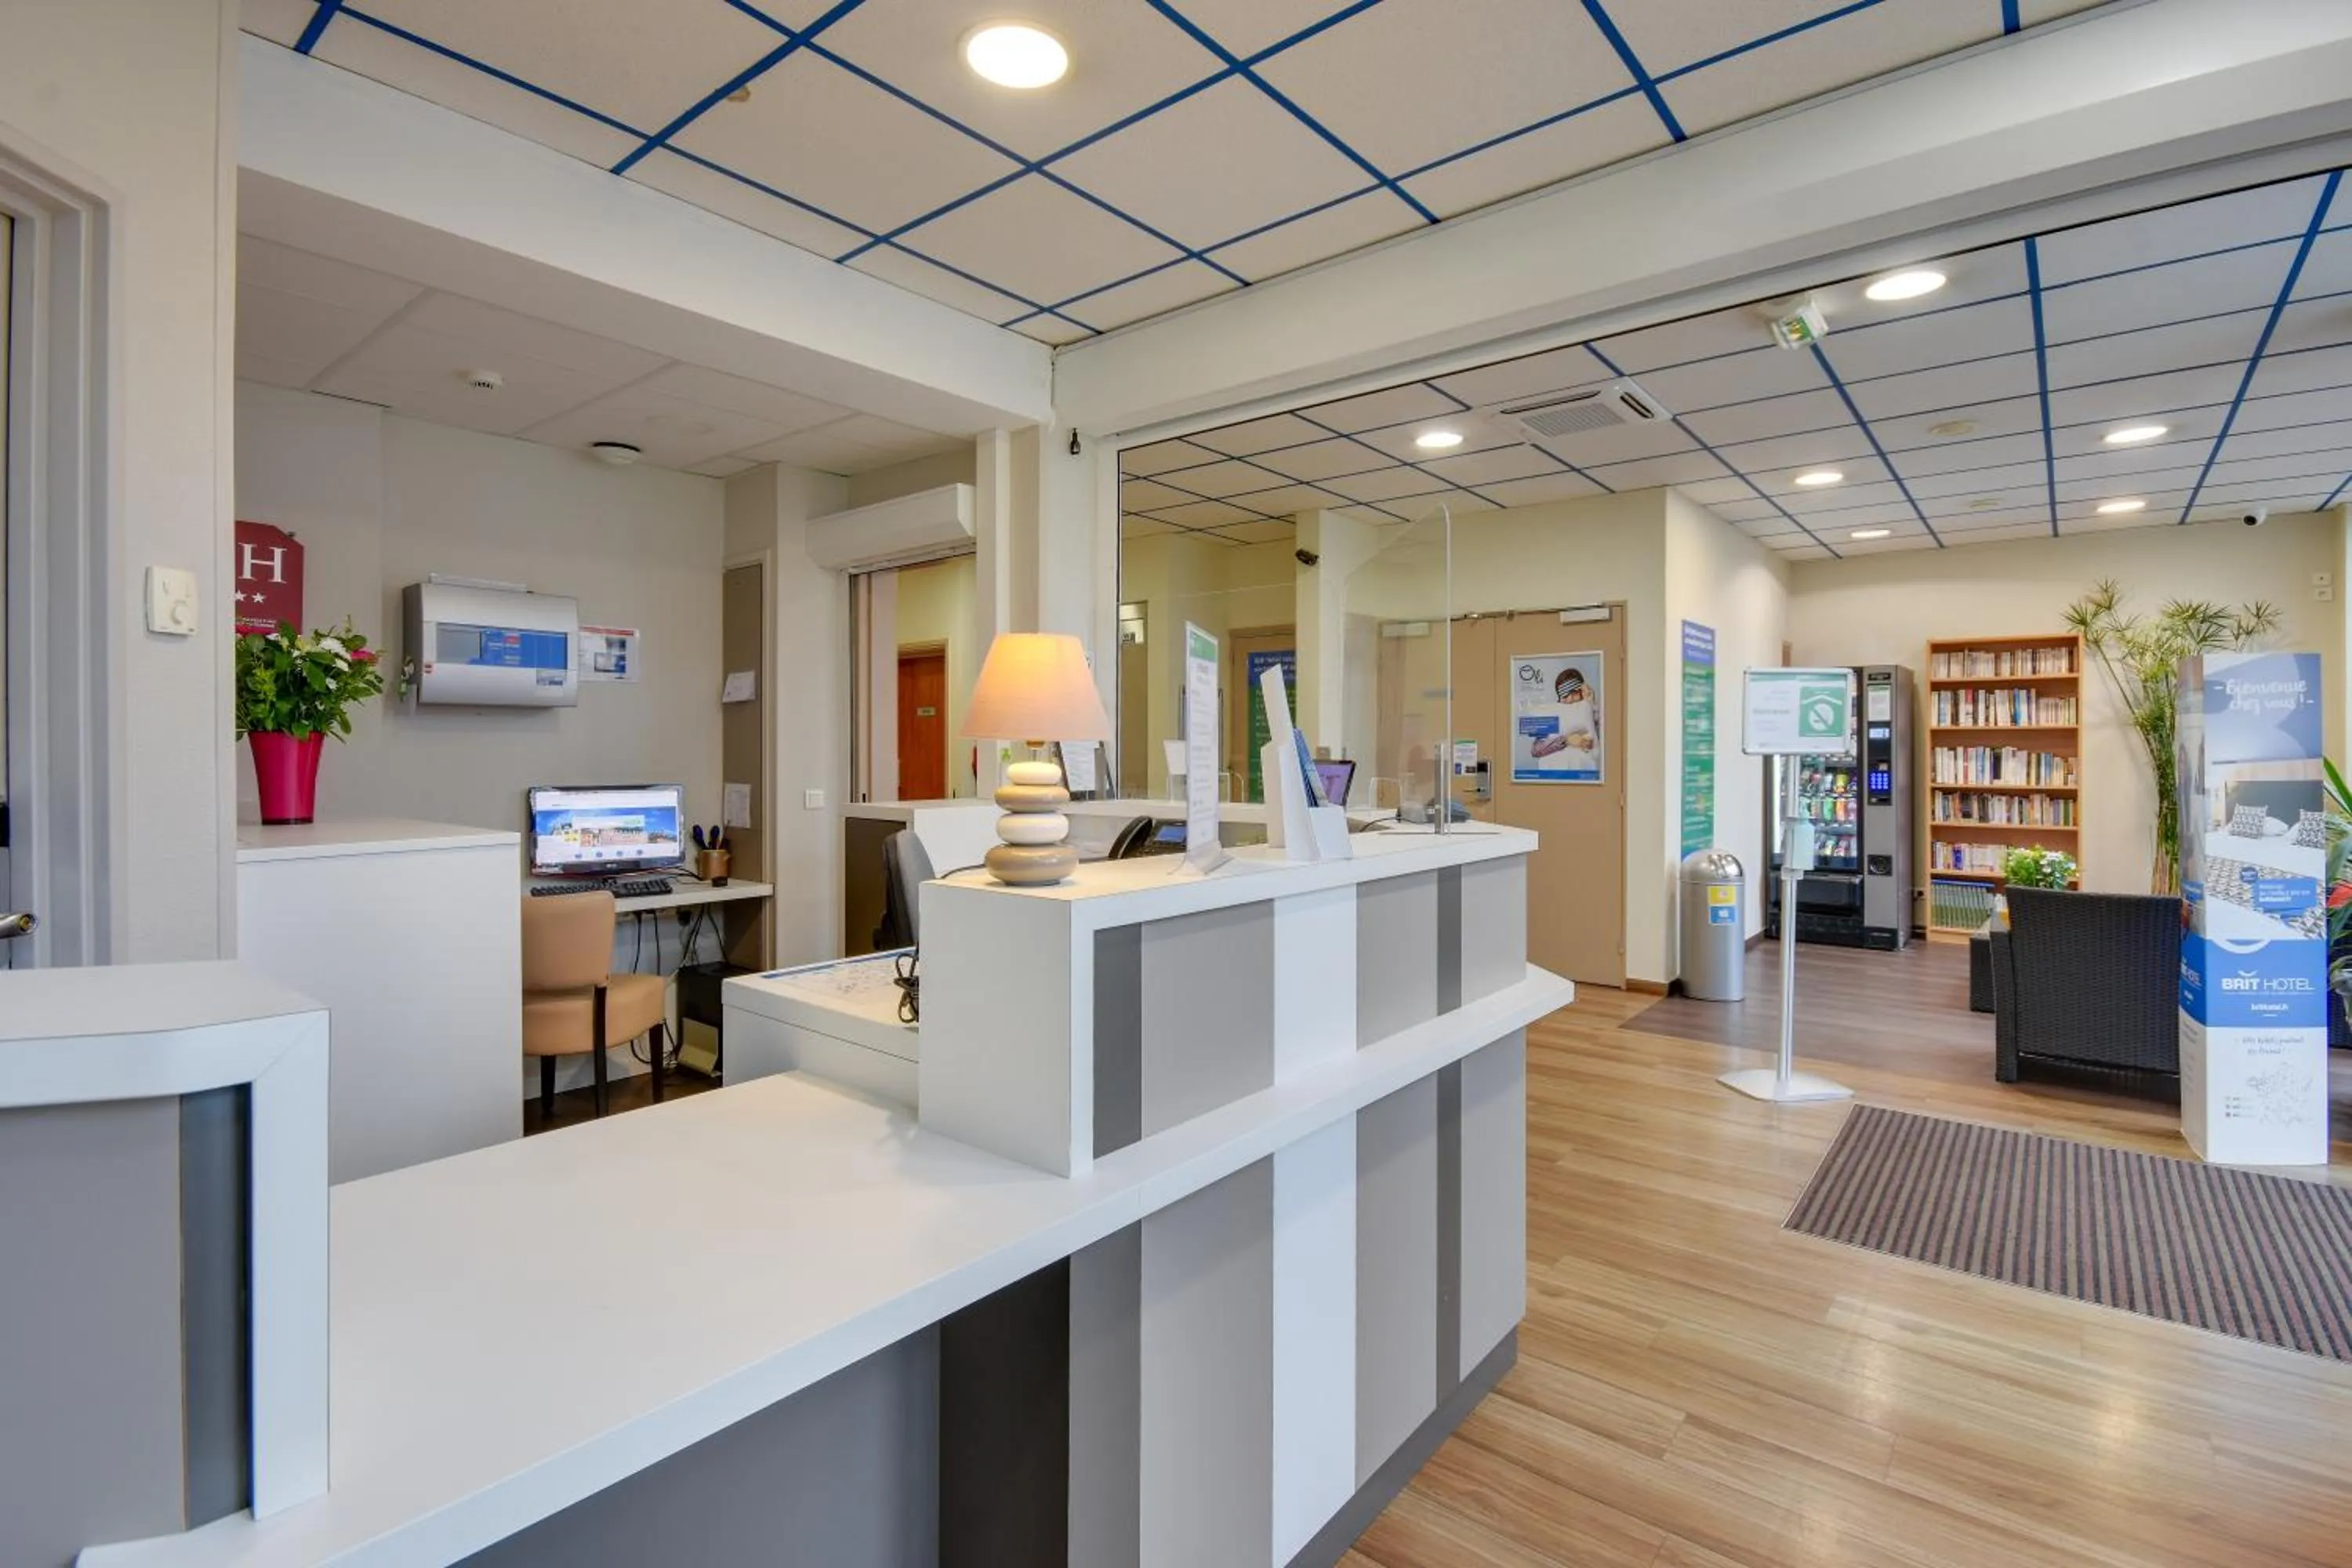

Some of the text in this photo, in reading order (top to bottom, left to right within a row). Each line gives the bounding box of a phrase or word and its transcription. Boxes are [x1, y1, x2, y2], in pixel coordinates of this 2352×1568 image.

[238, 542, 288, 584] H
[2221, 978, 2315, 991] BRIT HOTEL
